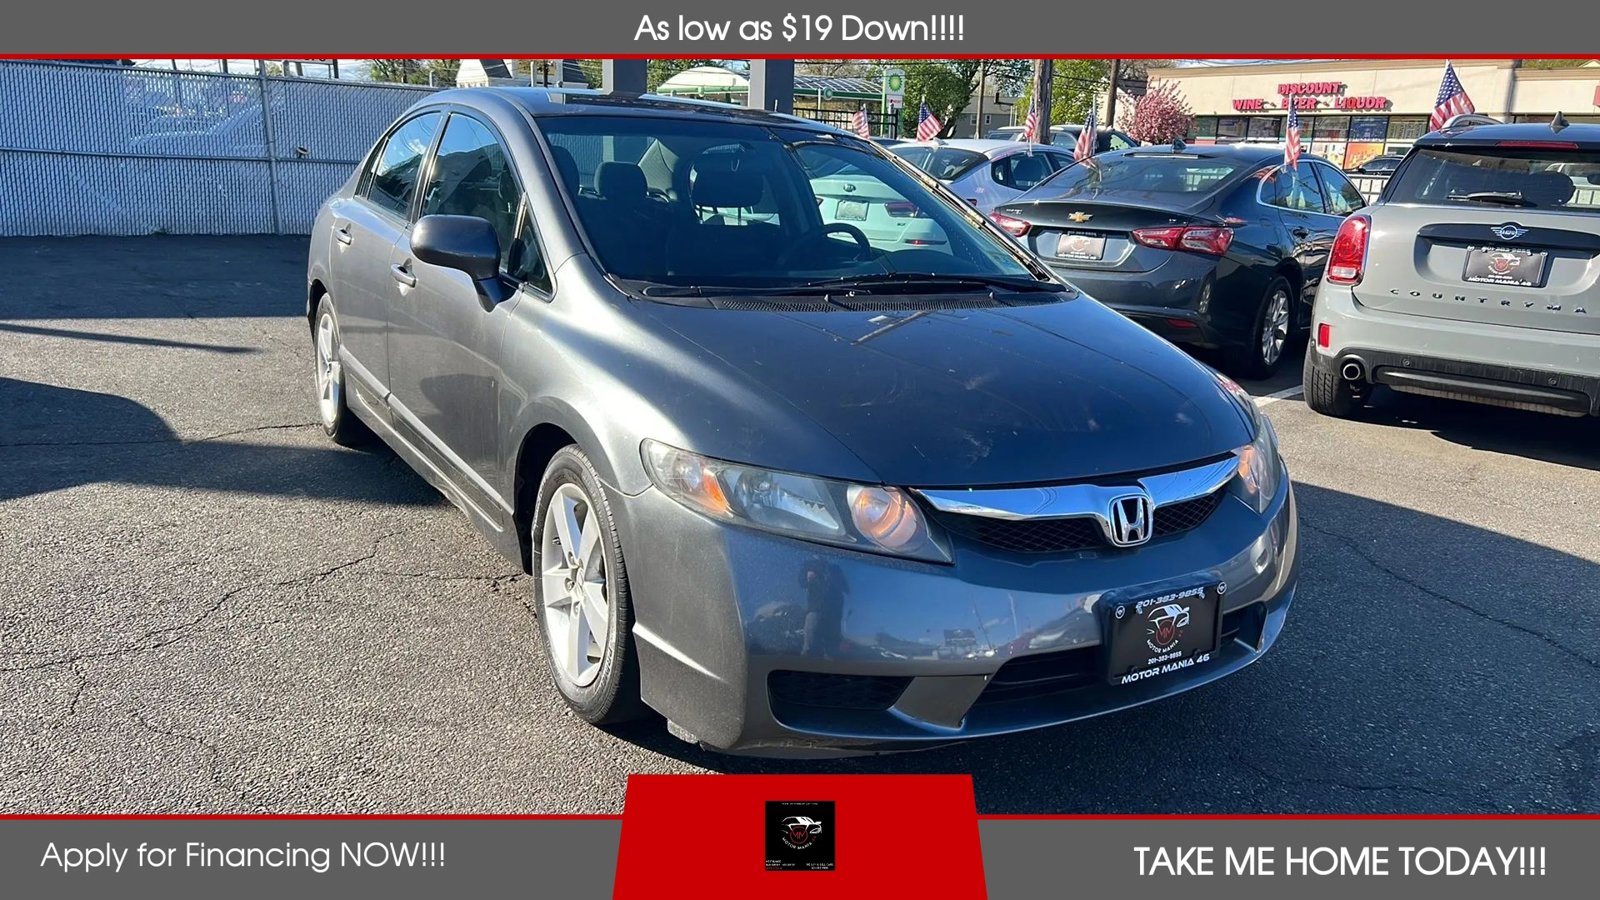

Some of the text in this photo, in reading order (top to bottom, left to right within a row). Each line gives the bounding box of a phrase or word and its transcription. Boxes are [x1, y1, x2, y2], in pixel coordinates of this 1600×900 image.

[1278, 82, 1342, 95] DISCOUNT
[1233, 99, 1264, 111] WINE
[1335, 96, 1387, 110] LIQUOR
[1147, 639, 1178, 653] MOTOR MANIA
[1121, 653, 1211, 684] MOTOR MANIA 46
